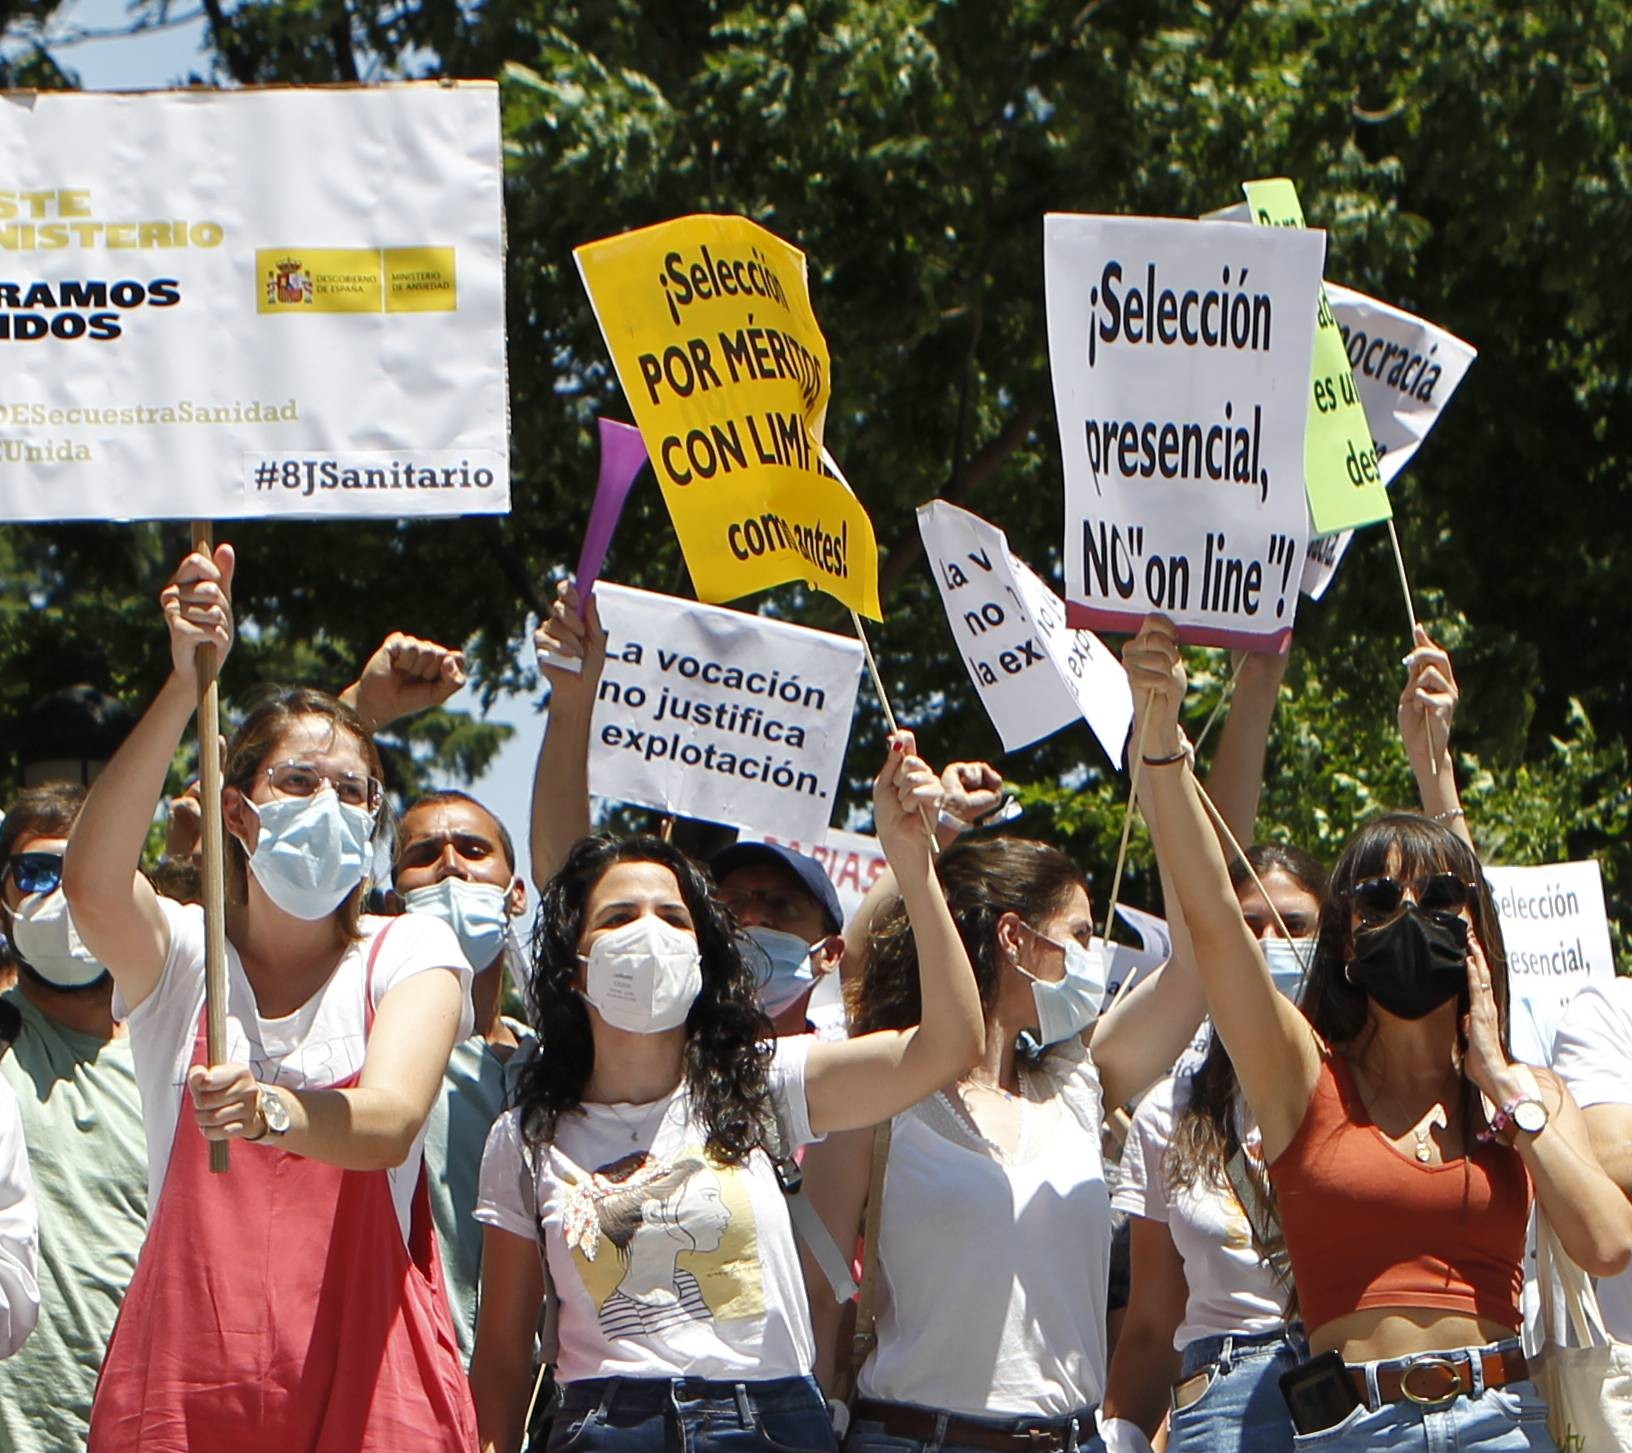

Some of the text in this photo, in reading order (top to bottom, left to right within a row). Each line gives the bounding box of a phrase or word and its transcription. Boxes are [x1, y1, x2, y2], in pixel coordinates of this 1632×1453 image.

[391, 271, 441, 281] MINISTERIO
[1087, 260, 1272, 368] ¡Selección
[639, 338, 722, 405] POR
[254, 460, 495, 497] #8JSanitario
[662, 420, 748, 486] CON
[1085, 402, 1268, 503] presencial,
[657, 648, 826, 710] vocación
[598, 678, 805, 749] no justifica
[601, 723, 827, 798] explotación.
